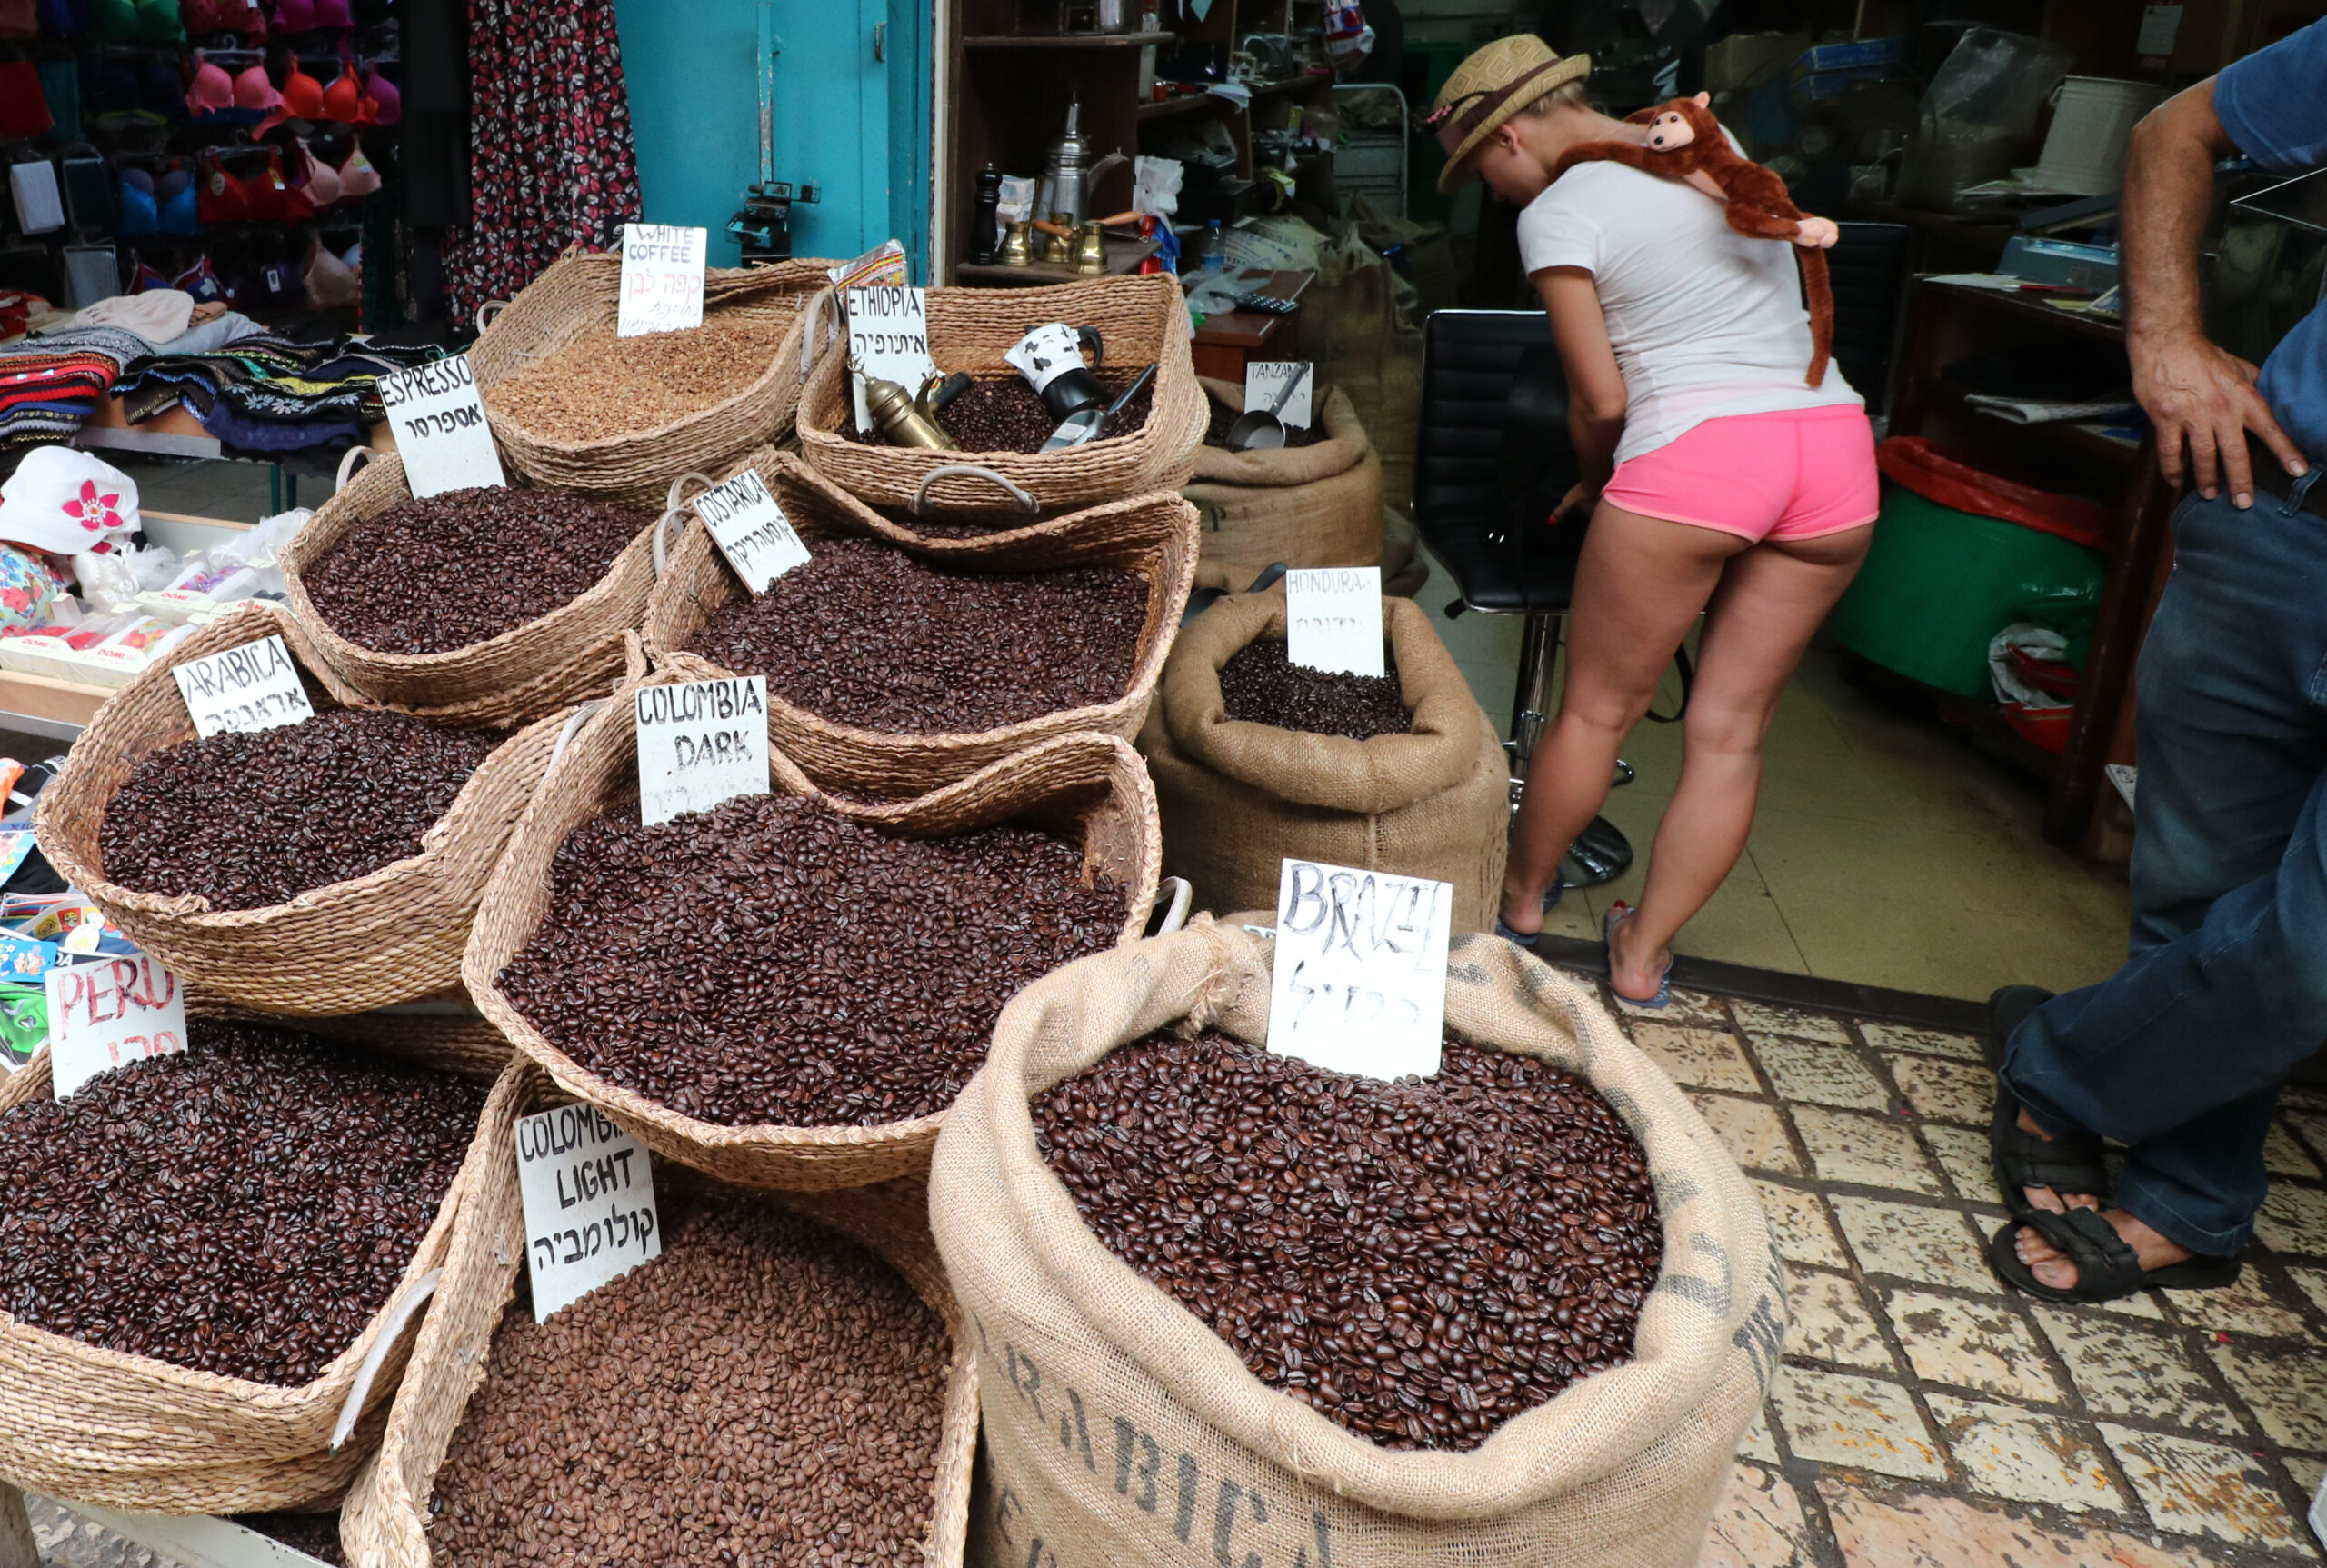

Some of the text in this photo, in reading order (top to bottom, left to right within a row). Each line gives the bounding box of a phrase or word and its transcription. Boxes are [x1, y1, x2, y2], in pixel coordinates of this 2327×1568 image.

[629, 243, 692, 263] COFFEE
[636, 225, 694, 244] WHITE
[625, 267, 701, 305] קפה לבן
[848, 286, 922, 318] ETHIOPIA
[377, 355, 473, 407] ESPRESSO
[405, 403, 483, 438] אספרסו
[696, 471, 770, 527] COSTARICA
[97, 648, 126, 660] DOMI
[185, 637, 292, 704] ARABICA
[638, 678, 763, 725] COLOMBIA
[674, 730, 753, 770] DARK
[1283, 863, 1442, 974] BRAZIL
[58, 956, 175, 1041] PERU
[519, 1104, 624, 1163] COLOMB
[556, 1147, 634, 1210] LIGHT
[533, 1203, 654, 1271] קולומביה
